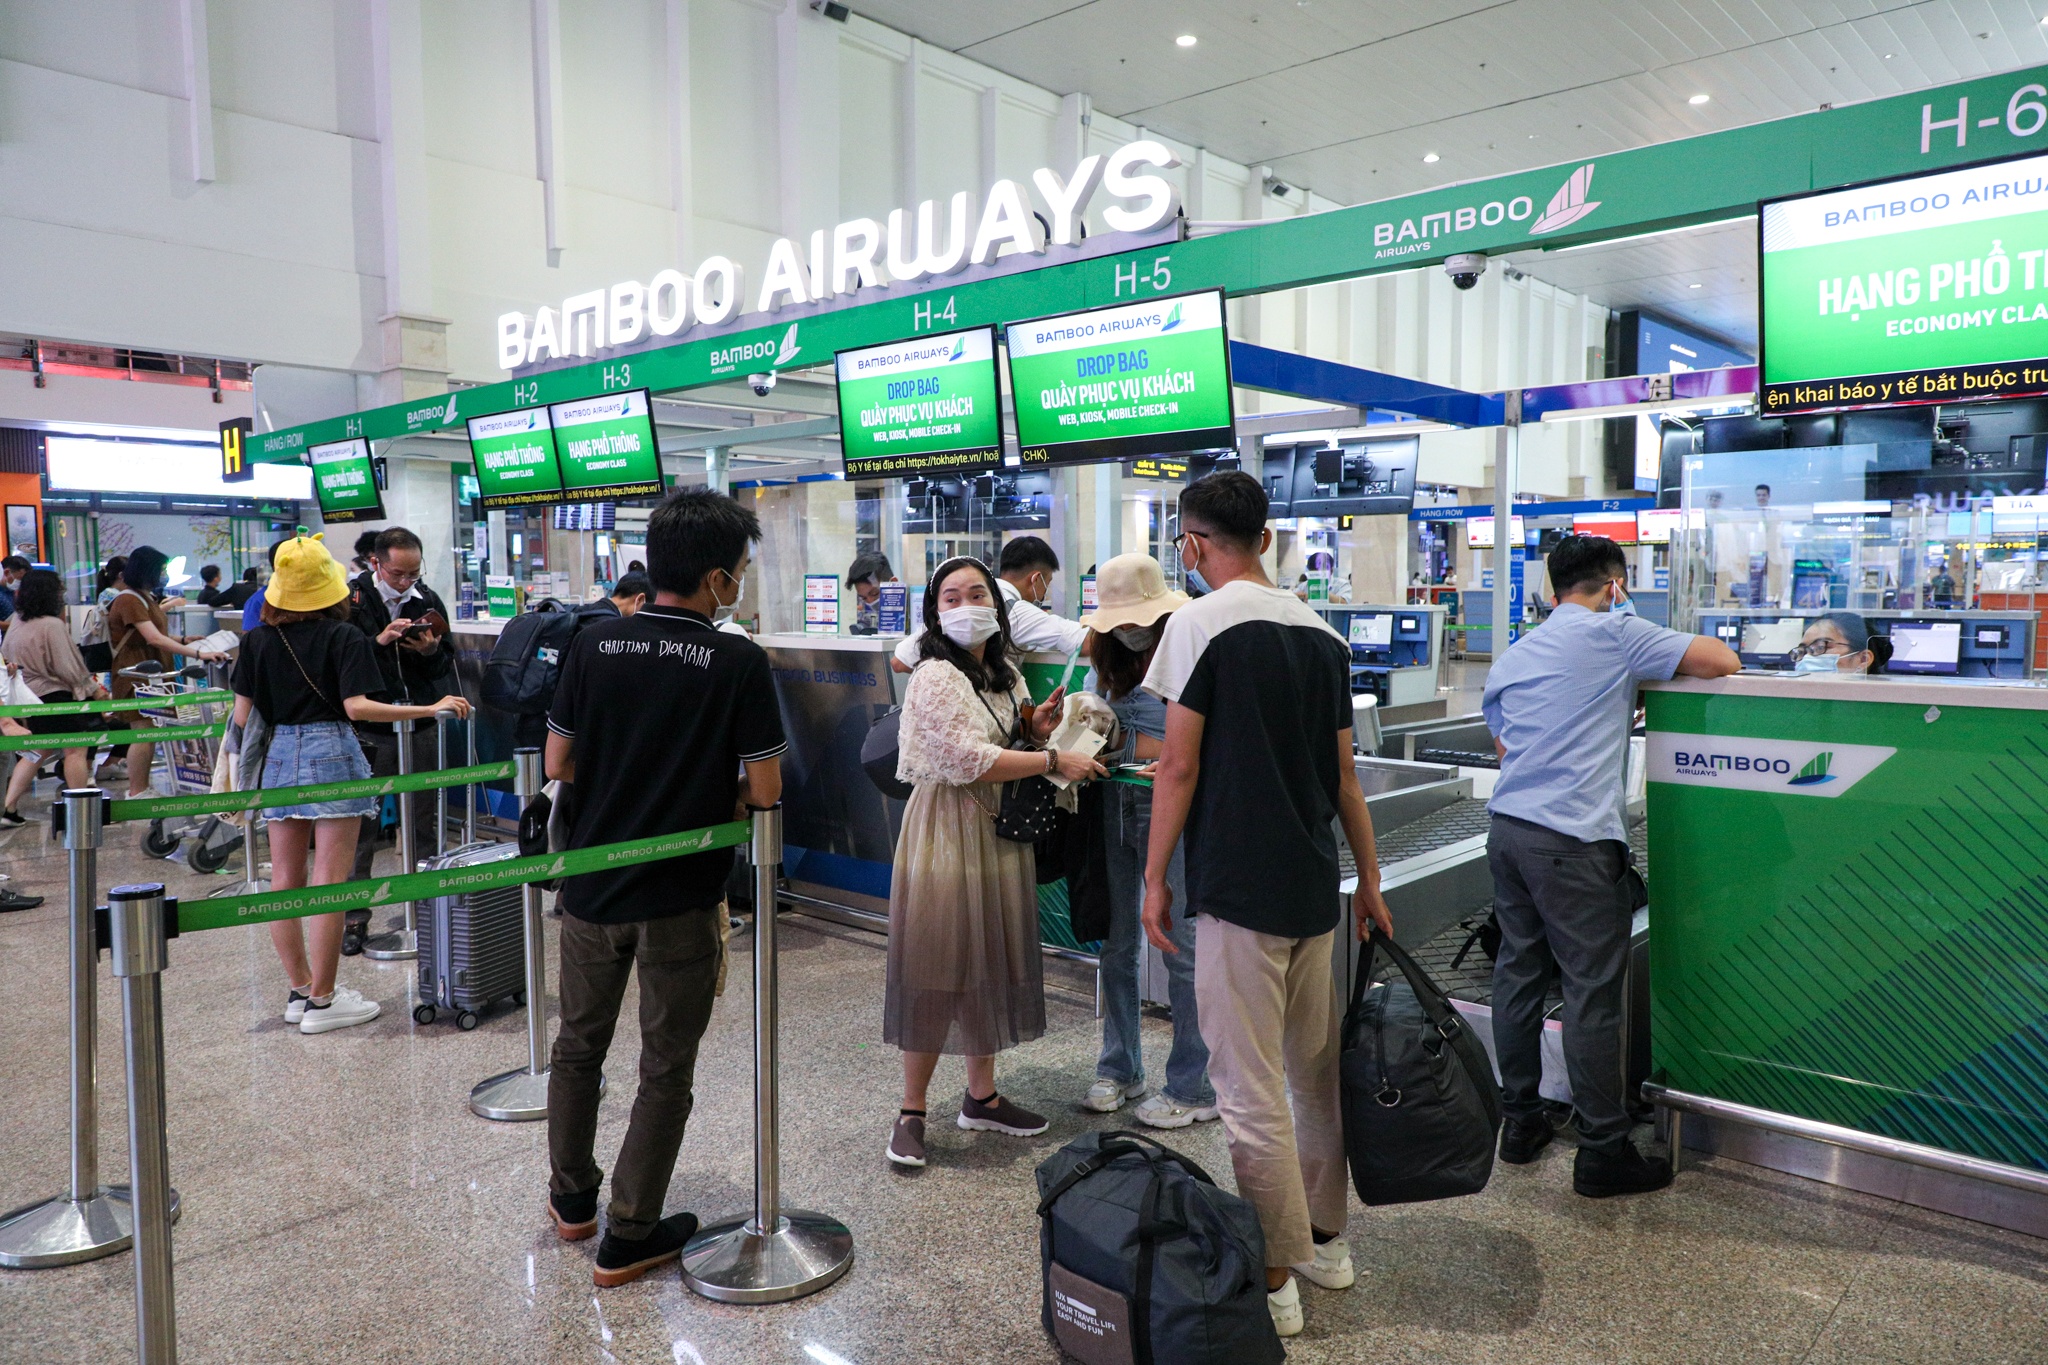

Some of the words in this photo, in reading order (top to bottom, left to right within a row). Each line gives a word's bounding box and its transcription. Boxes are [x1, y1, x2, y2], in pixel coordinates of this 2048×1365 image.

[1920, 84, 2047, 154] H-6
[1825, 194, 1950, 227] BAMBOO
[1962, 177, 2048, 205] AIRW
[1374, 196, 1532, 247] BAMBOO
[498, 254, 742, 370] BAMBOO
[758, 140, 1182, 313] AIRWAYS
[1374, 241, 1431, 259] AIRWAYS
[1114, 256, 1171, 297] H-5
[1819, 268, 1920, 321] HẠNG
[1930, 239, 2010, 302] PHỔ
[914, 295, 957, 331] H-4
[1886, 308, 1998, 337] ECONOMY
[1036, 325, 1095, 344] BAMBOO
[1099, 314, 1161, 334] AIRWAYS
[710, 340, 775, 366] BAMBOO
[858, 354, 901, 370] BAMBOO
[904, 346, 949, 362] AIRWAYS
[1077, 353, 1115, 378] DROP
[1118, 349, 1148, 373] BAG
[603, 363, 631, 390] H-3
[711, 364, 735, 374] AIRWAYS
[514, 381, 538, 406] H-2
[887, 380, 915, 400] DROP
[917, 376, 939, 396] BAG
[1041, 379, 1077, 410] QUẦY
[1079, 381, 1117, 408] PHỤC
[1118, 379, 1141, 404] VỤ
[1142, 368, 1195, 396] KHÁCH
[1795, 385, 1833, 403] khai
[1840, 382, 1875, 399] báo
[1881, 383, 1892, 399] y
[1897, 375, 1919, 395] tế
[1924, 372, 1957, 393] bắt
[1963, 369, 2017, 390] buộc
[407, 405, 444, 424] BAMBOO
[564, 408, 591, 419] BAMBOO
[592, 403, 621, 415] AIRWAYS
[860, 402, 888, 428] QUẦY
[889, 402, 917, 427] PHỤC
[919, 401, 934, 424] VỤ
[935, 393, 973, 419] KHÁCH
[1058, 412, 1079, 427] WEB,
[1080, 410, 1106, 424] KIOSK,
[1107, 406, 1137, 421] MOBILE
[1138, 402, 1178, 417] CHECK-IN
[346, 418, 362, 437] H-1
[480, 421, 502, 432] BAMBOO
[503, 418, 528, 429] AIRWAYS
[909, 426, 931, 438] MOBILE
[932, 423, 961, 436] CHECK-IN
[222, 426, 241, 475] H
[586, 461, 609, 471] ECONOMY
[610, 458, 627, 468] CLASS
[1603, 501, 1620, 510] F-2
[599, 640, 650, 655] CHRISTIAN
[52, 704, 80, 712] AIRWAYS
[24, 738, 60, 746] BAMBOO
[61, 736, 96, 744] AIRWAYS
[171, 729, 202, 737] AIRWAYS
[1675, 751, 1791, 774] BAMBOO
[1675, 767, 1717, 777] AIRWAYS
[425, 774, 461, 785] BAMBOO
[463, 768, 498, 779] AIRWAYS
[297, 788, 336, 799] BAMBOO
[338, 783, 380, 795] AIRWAYS
[152, 802, 199, 813] BAMBOO
[201, 797, 247, 808] AIRWAYS
[607, 846, 653, 862] BAMBOO
[655, 837, 698, 855] AIRWAYS
[438, 873, 493, 889] BAMBOO
[496, 863, 548, 879] AIRWAYS
[238, 898, 303, 916] BAMBOO
[308, 889, 369, 906] AIRWAYS
[1055, 1300, 1074, 1316] YOUR
[1074, 1309, 1099, 1326] TRAVEL
[1100, 1320, 1116, 1331] LIFE
[1057, 1310, 1072, 1323] EASY
[1088, 1325, 1104, 1336] FUN
